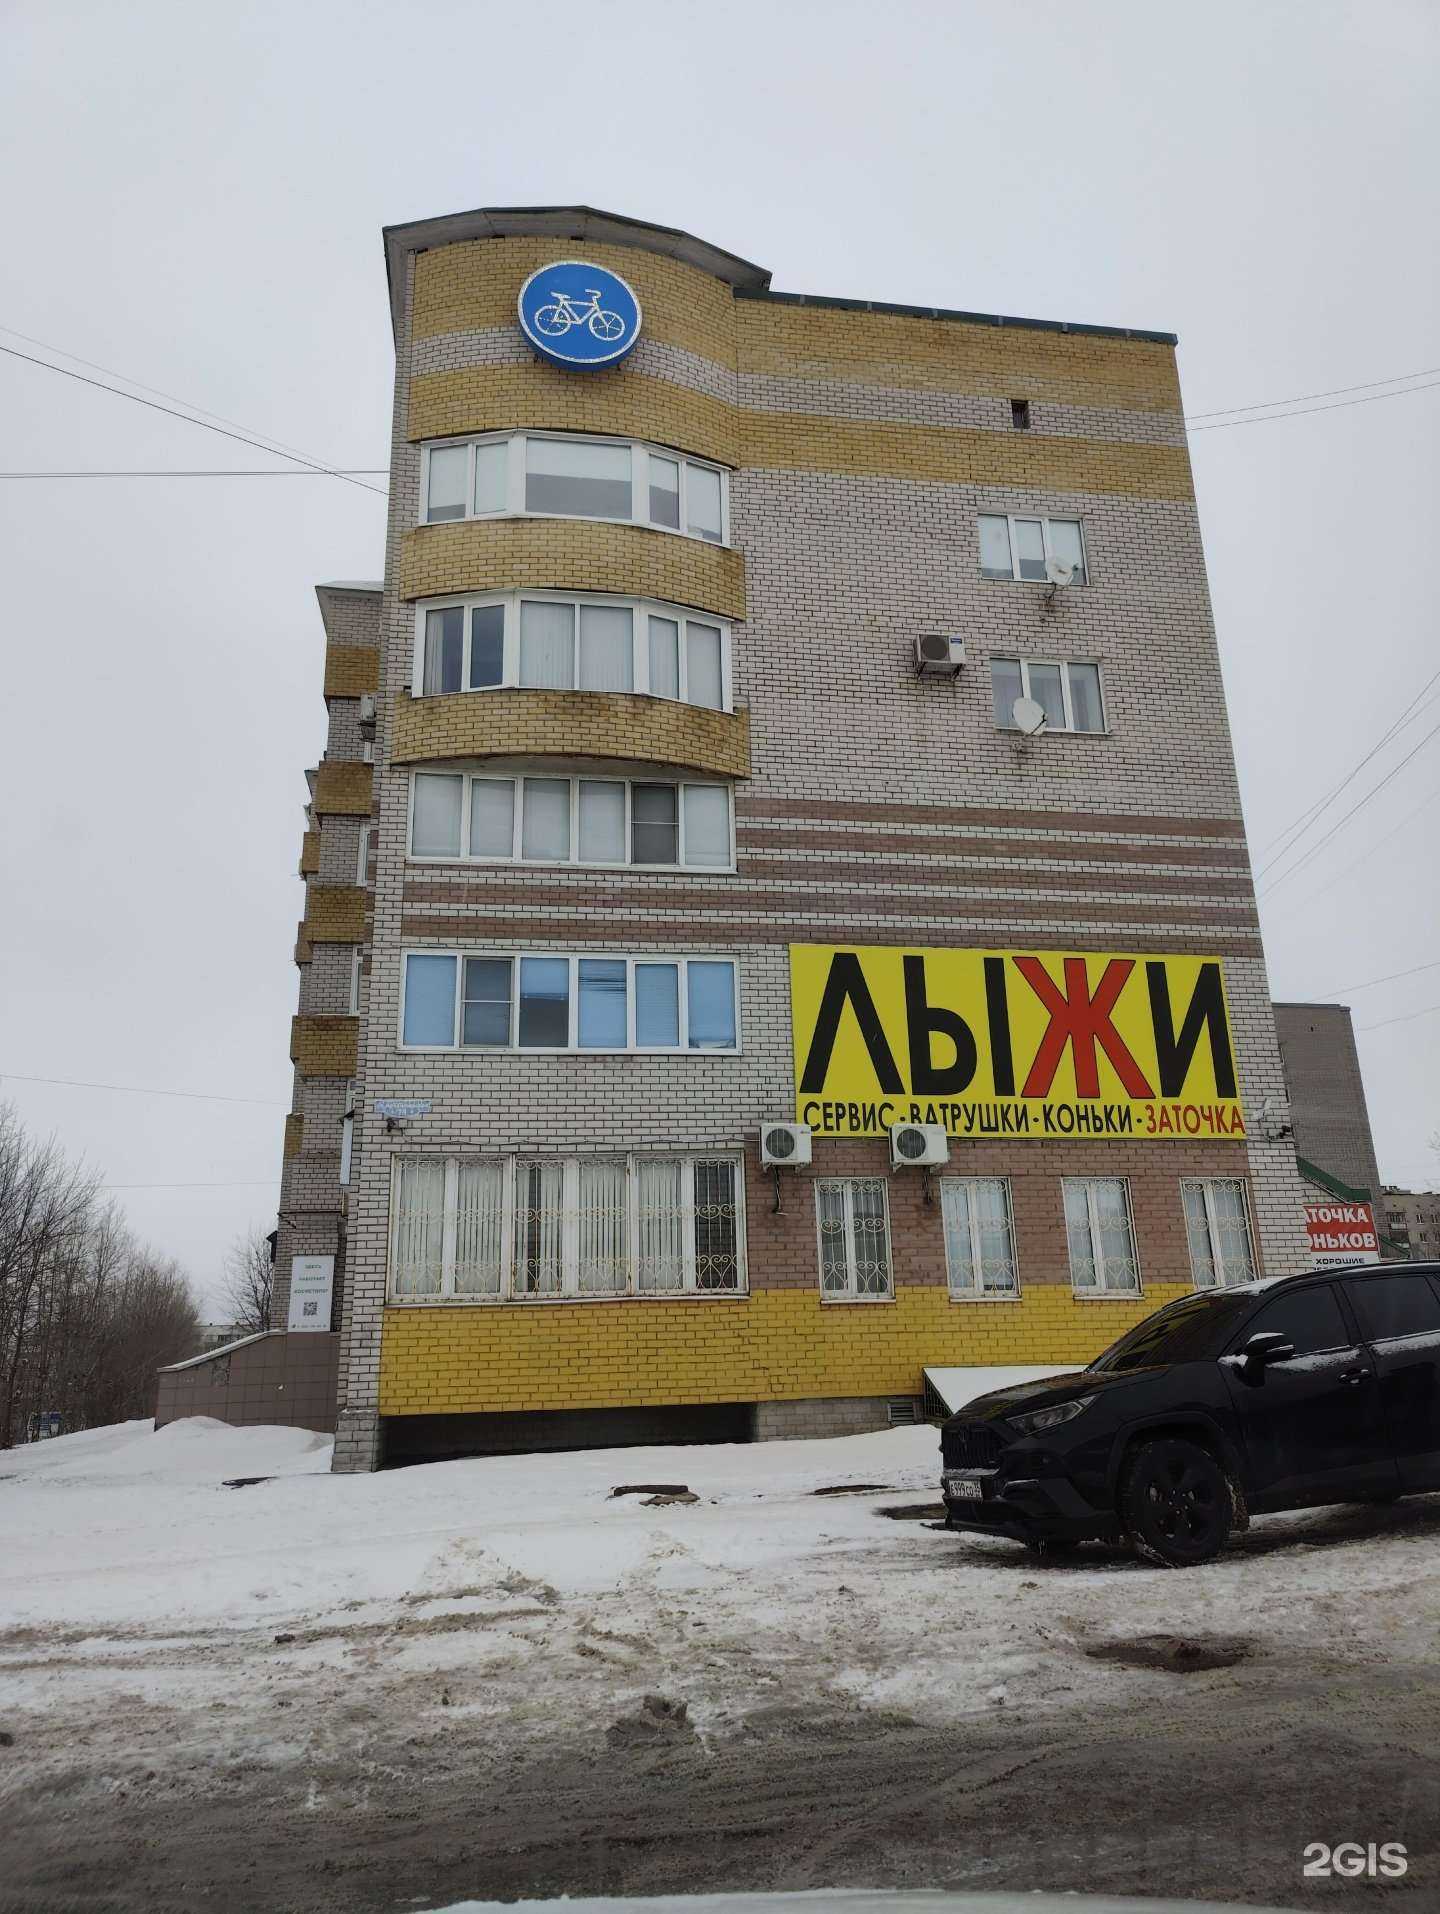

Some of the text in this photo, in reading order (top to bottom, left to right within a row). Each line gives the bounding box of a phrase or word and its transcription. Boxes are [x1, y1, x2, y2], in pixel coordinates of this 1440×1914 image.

[799, 952, 1238, 1099] ЛЫЖИ
[803, 1101, 1246, 1134] СЕРВИС ВАТРУШКИ КОНЬКИ ЗАТОЧКА
[1315, 1257, 1365, 1265] ХОРОШИЕ
